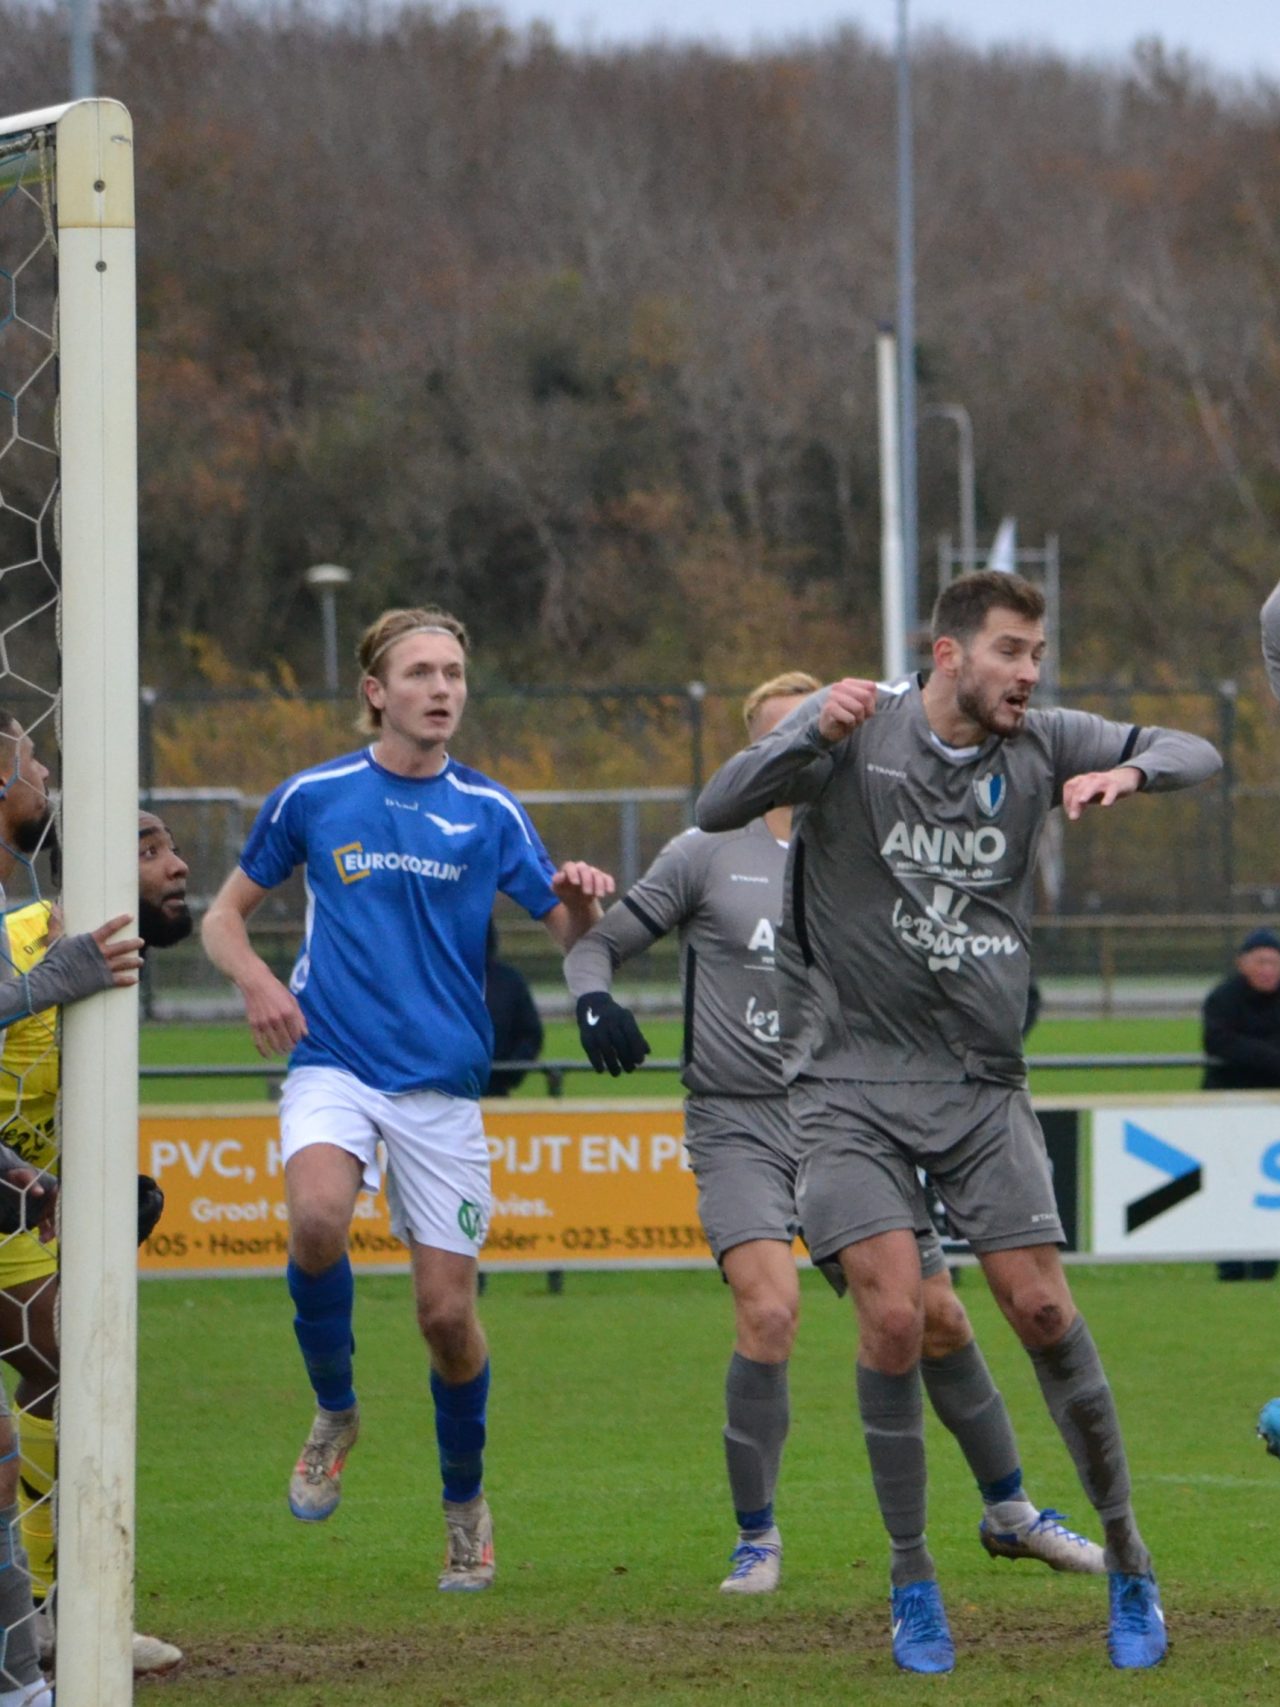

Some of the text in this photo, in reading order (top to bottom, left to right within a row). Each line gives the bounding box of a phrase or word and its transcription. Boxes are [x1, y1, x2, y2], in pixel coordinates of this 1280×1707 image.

[880, 821, 1007, 866] ANNO
[151, 1140, 256, 1184] PVC,
[486, 1135, 572, 1173] PIJT
[580, 1136, 641, 1172] EN
[191, 1198, 269, 1223] Groot
[210, 1232, 289, 1255] Haarl
